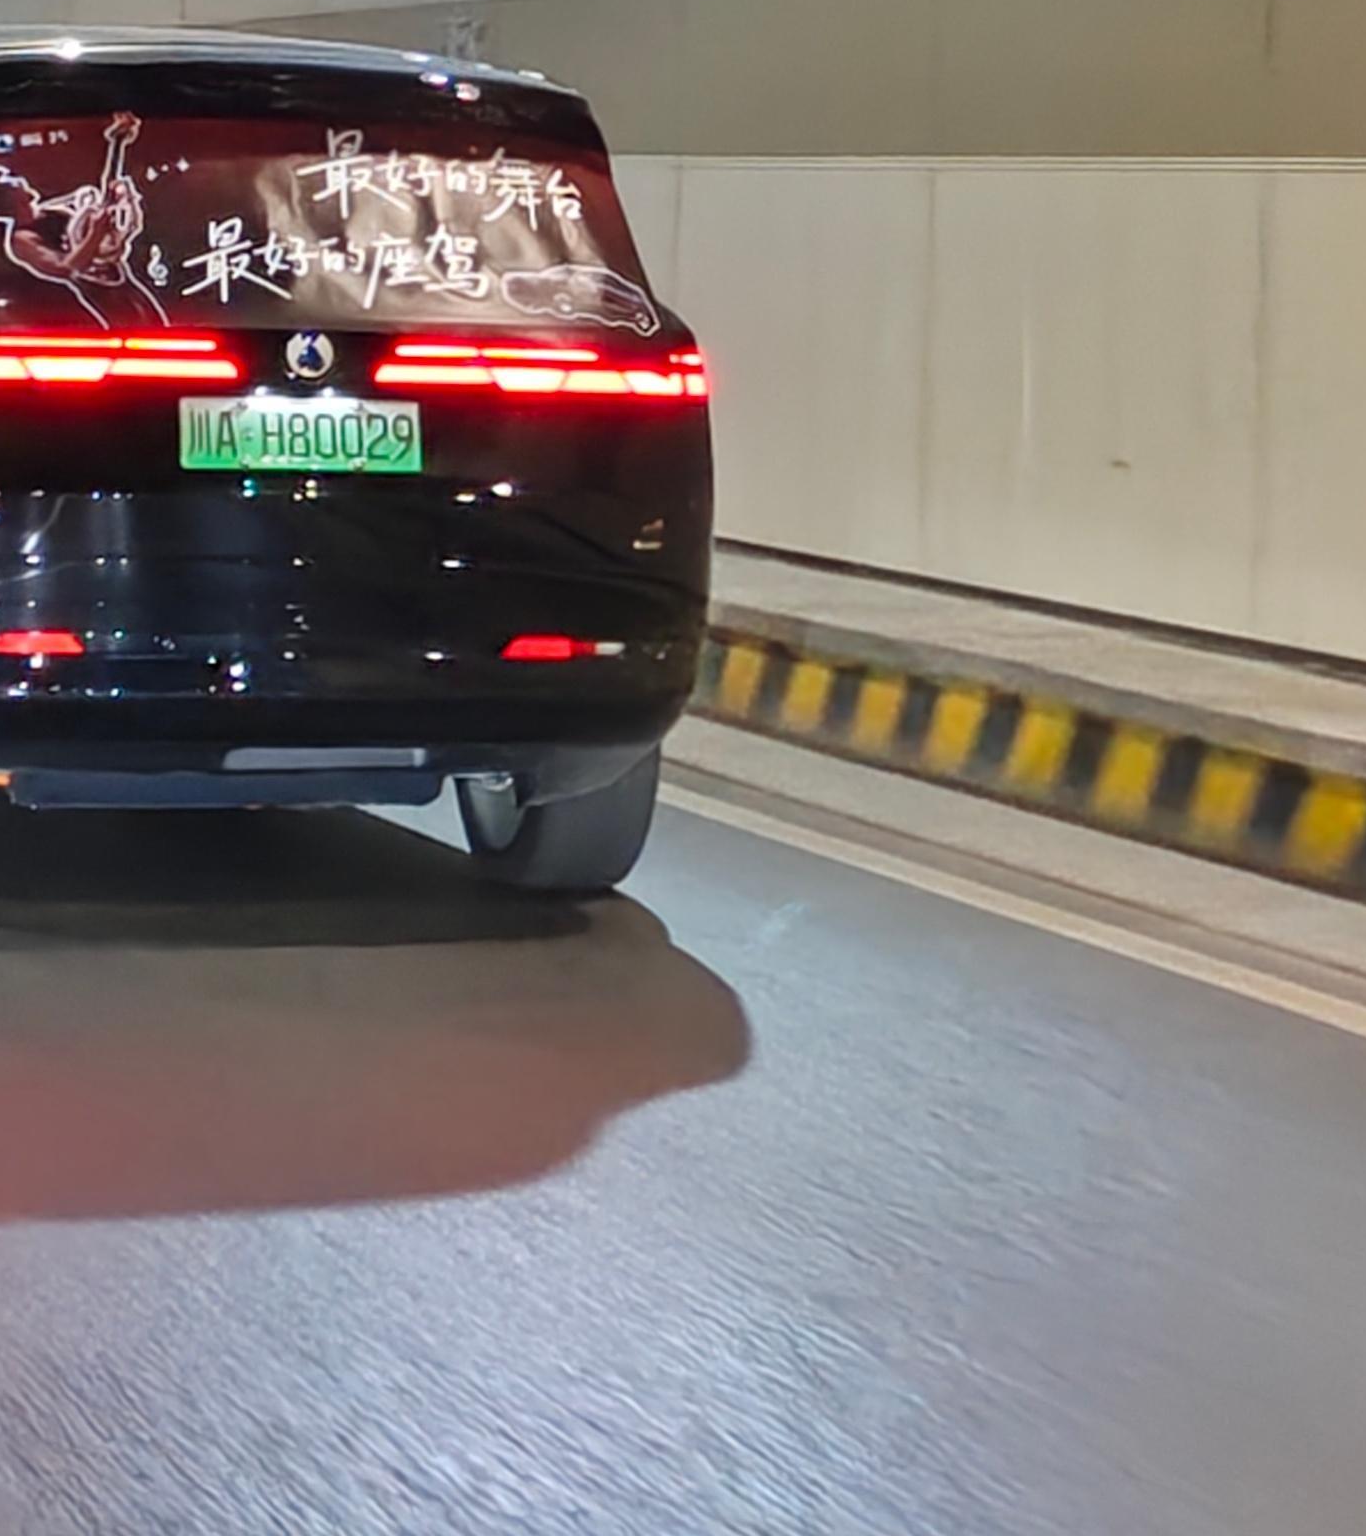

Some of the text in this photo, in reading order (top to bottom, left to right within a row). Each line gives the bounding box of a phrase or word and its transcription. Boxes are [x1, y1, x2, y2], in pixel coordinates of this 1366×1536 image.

[296, 128, 583, 231] 最好的舞台
[182, 216, 489, 310] 最好的座驾
